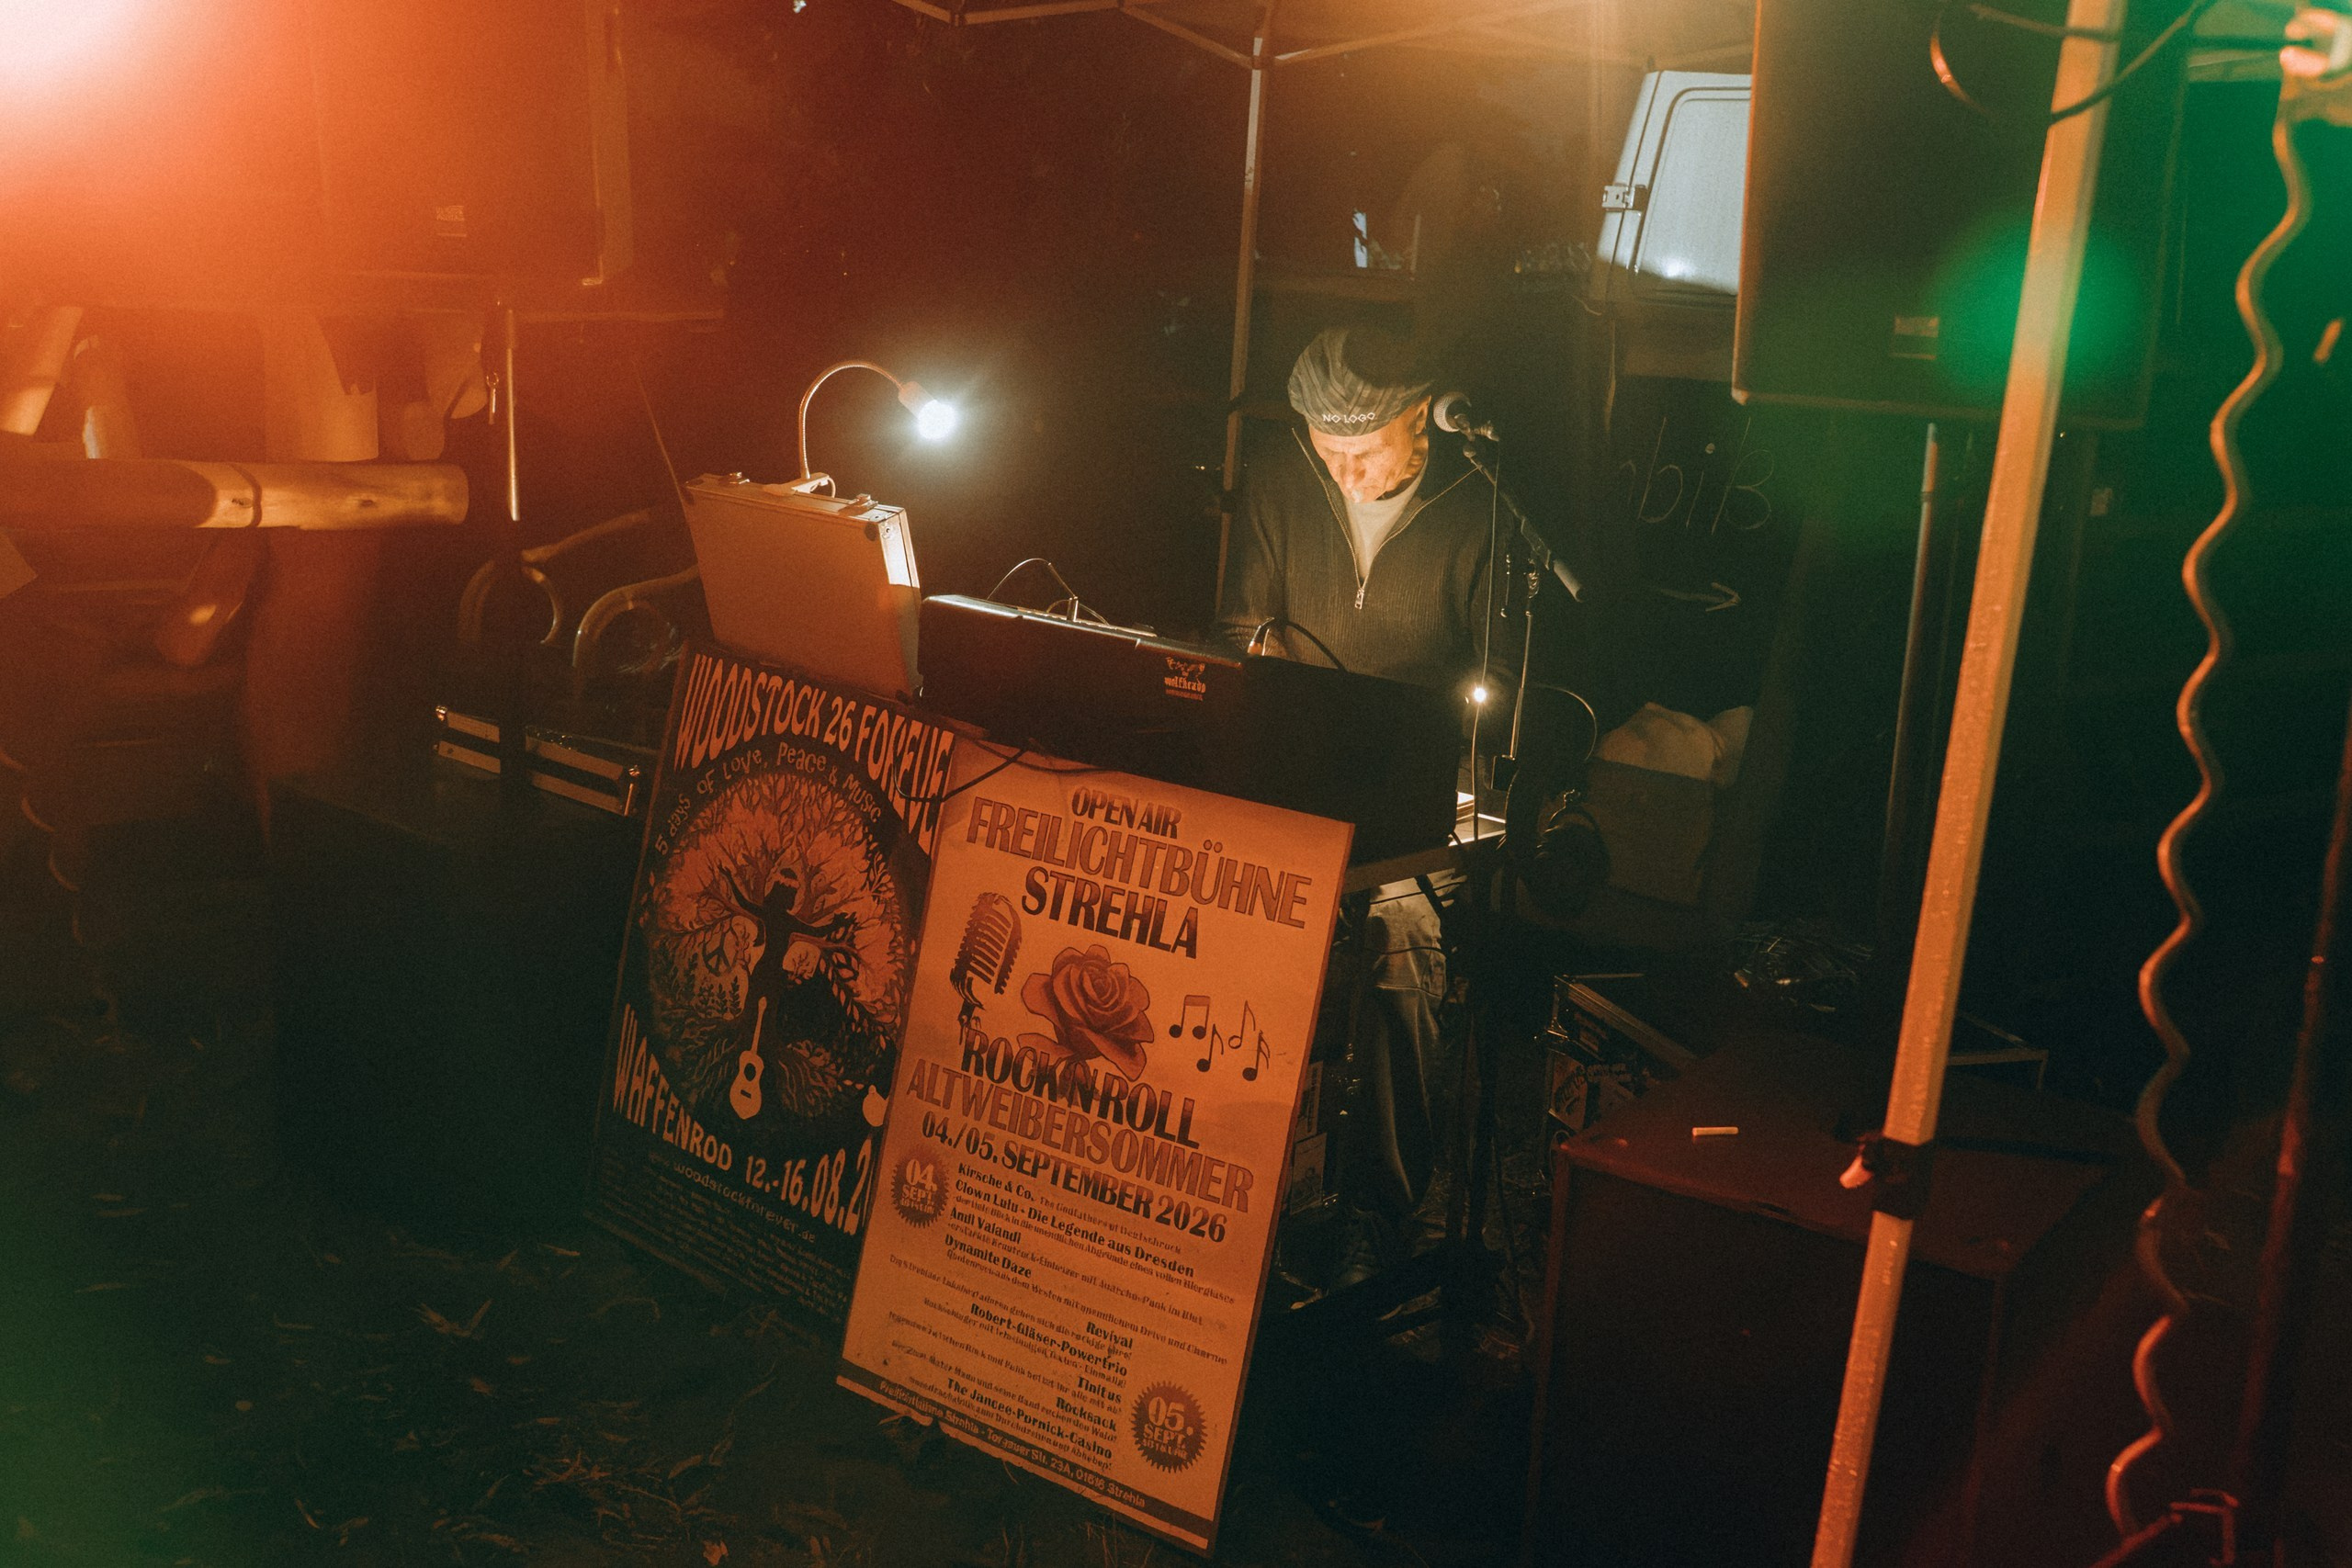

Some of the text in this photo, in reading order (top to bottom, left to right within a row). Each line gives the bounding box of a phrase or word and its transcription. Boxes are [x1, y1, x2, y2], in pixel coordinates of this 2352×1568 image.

[1322, 412, 1375, 423] NO LOGO
[674, 653, 955, 855] WOODSTOCK 26 FOREVE
[655, 834, 669, 856] 5
[829, 766, 838, 785] &
[1071, 792, 1181, 839] OPEN AIR
[967, 795, 1312, 929] FREILICHTBÜHNE
[1022, 866, 1198, 958] STREHLA
[614, 1003, 732, 1171] WAFFENROD
[907, 1059, 1252, 1211] ALTWEIBERSOMMER
[746, 1138, 872, 1235] 12.-16.08.2
[957, 1162, 1002, 1189] Kirsche
[1003, 1180, 1012, 1193] &
[1001, 1141, 1152, 1218] SEPTEMBER
[1155, 1197, 1227, 1243] 2026
[944, 1234, 1032, 1278] Dynamite Daze
[955, 1179, 990, 1202] Clown
[992, 1193, 1019, 1213] Lulu
[1027, 1206, 1048, 1224] Die
[1050, 1215, 1105, 1246] Legende
[1107, 1239, 1131, 1256] aus
[1134, 1246, 1193, 1277] Dresden
[977, 1216, 1021, 1244] Valandi
[1086, 1321, 1133, 1349] Revival
[947, 1377, 967, 1395] The
[1056, 1396, 1116, 1431] Rocksack
[1148, 1395, 1193, 1437] 05.
